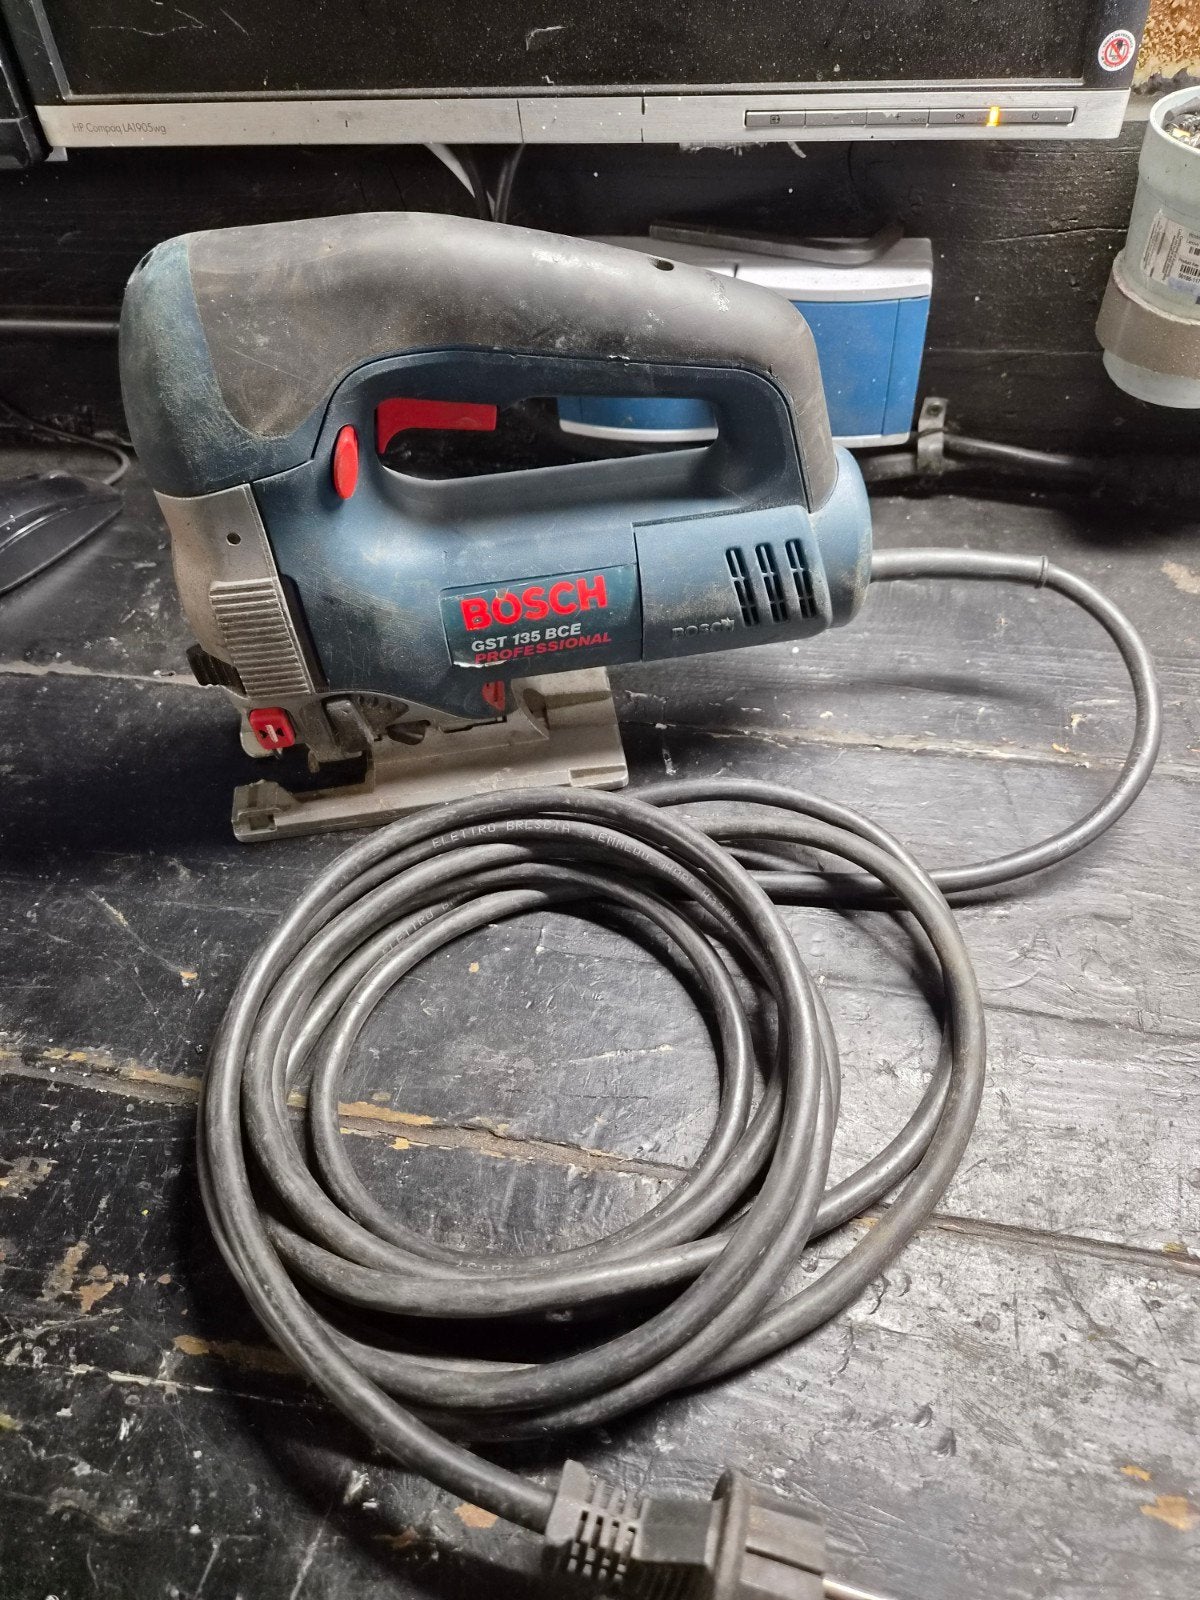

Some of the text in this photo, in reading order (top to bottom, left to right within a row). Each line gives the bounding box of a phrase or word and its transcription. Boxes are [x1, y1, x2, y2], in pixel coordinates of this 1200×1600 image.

[71, 122, 167, 135] HP Compaq LA1905wg
[461, 574, 608, 631] BOSCH
[471, 622, 582, 652] GST 135 BCE
[474, 631, 612, 665] PROFESSIONAL
[505, 818, 572, 833] BRESCIA
